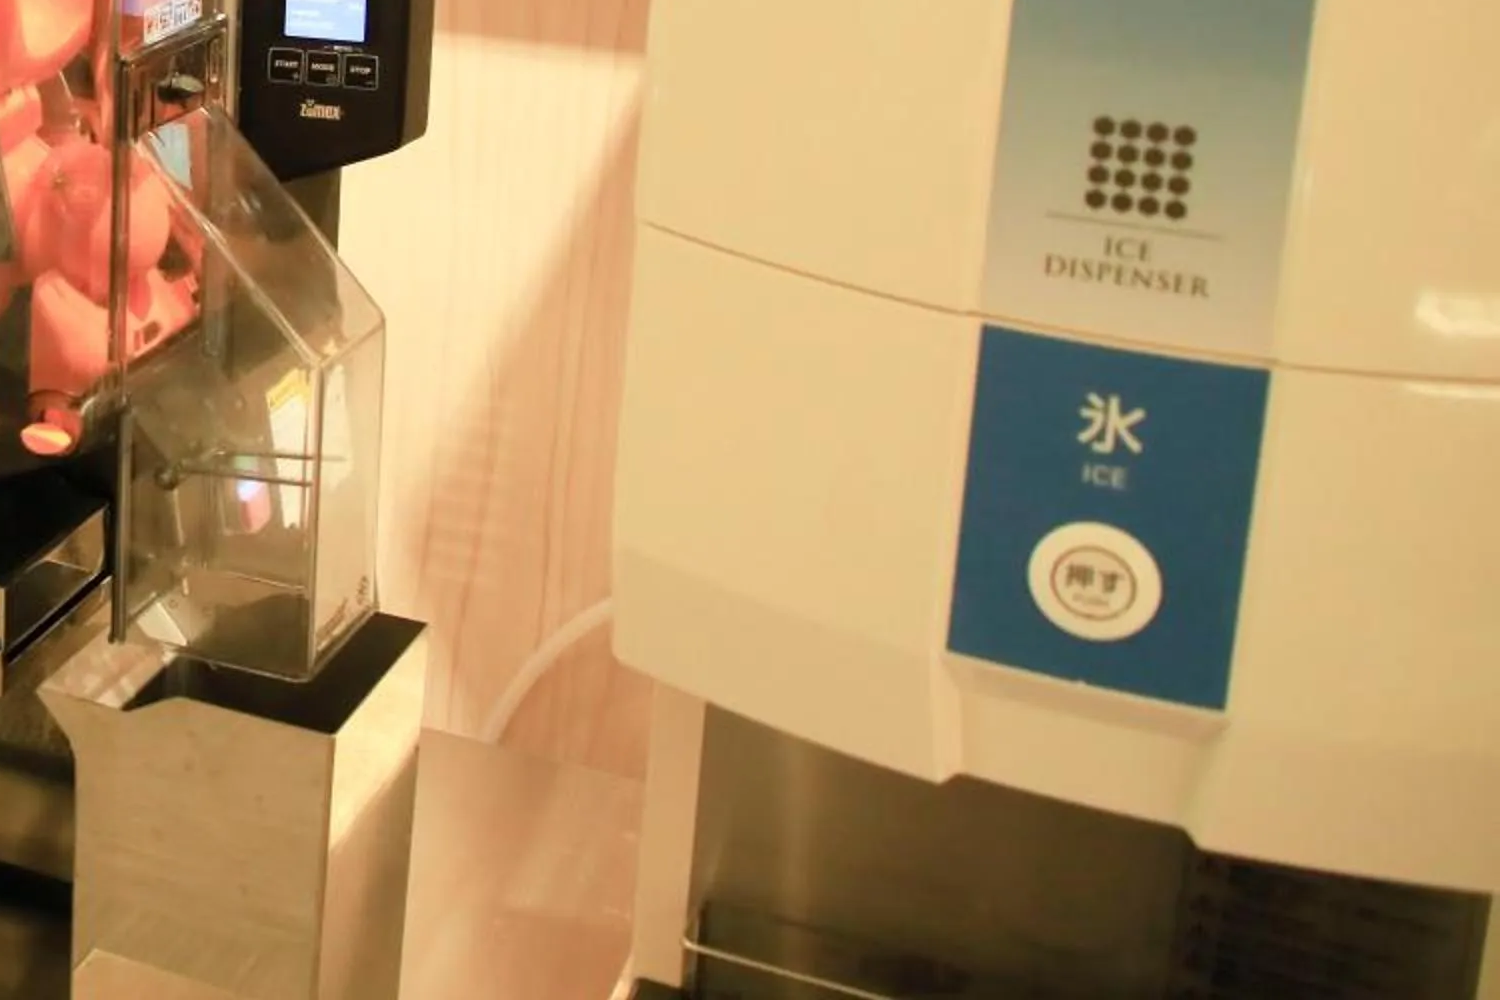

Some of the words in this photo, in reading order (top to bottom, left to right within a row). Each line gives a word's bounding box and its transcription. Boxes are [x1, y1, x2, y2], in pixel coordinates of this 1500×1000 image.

[1103, 235, 1149, 263] ICE
[1045, 253, 1209, 299] DISPENSER
[1076, 391, 1148, 455] 氷
[1080, 462, 1128, 489] ICE
